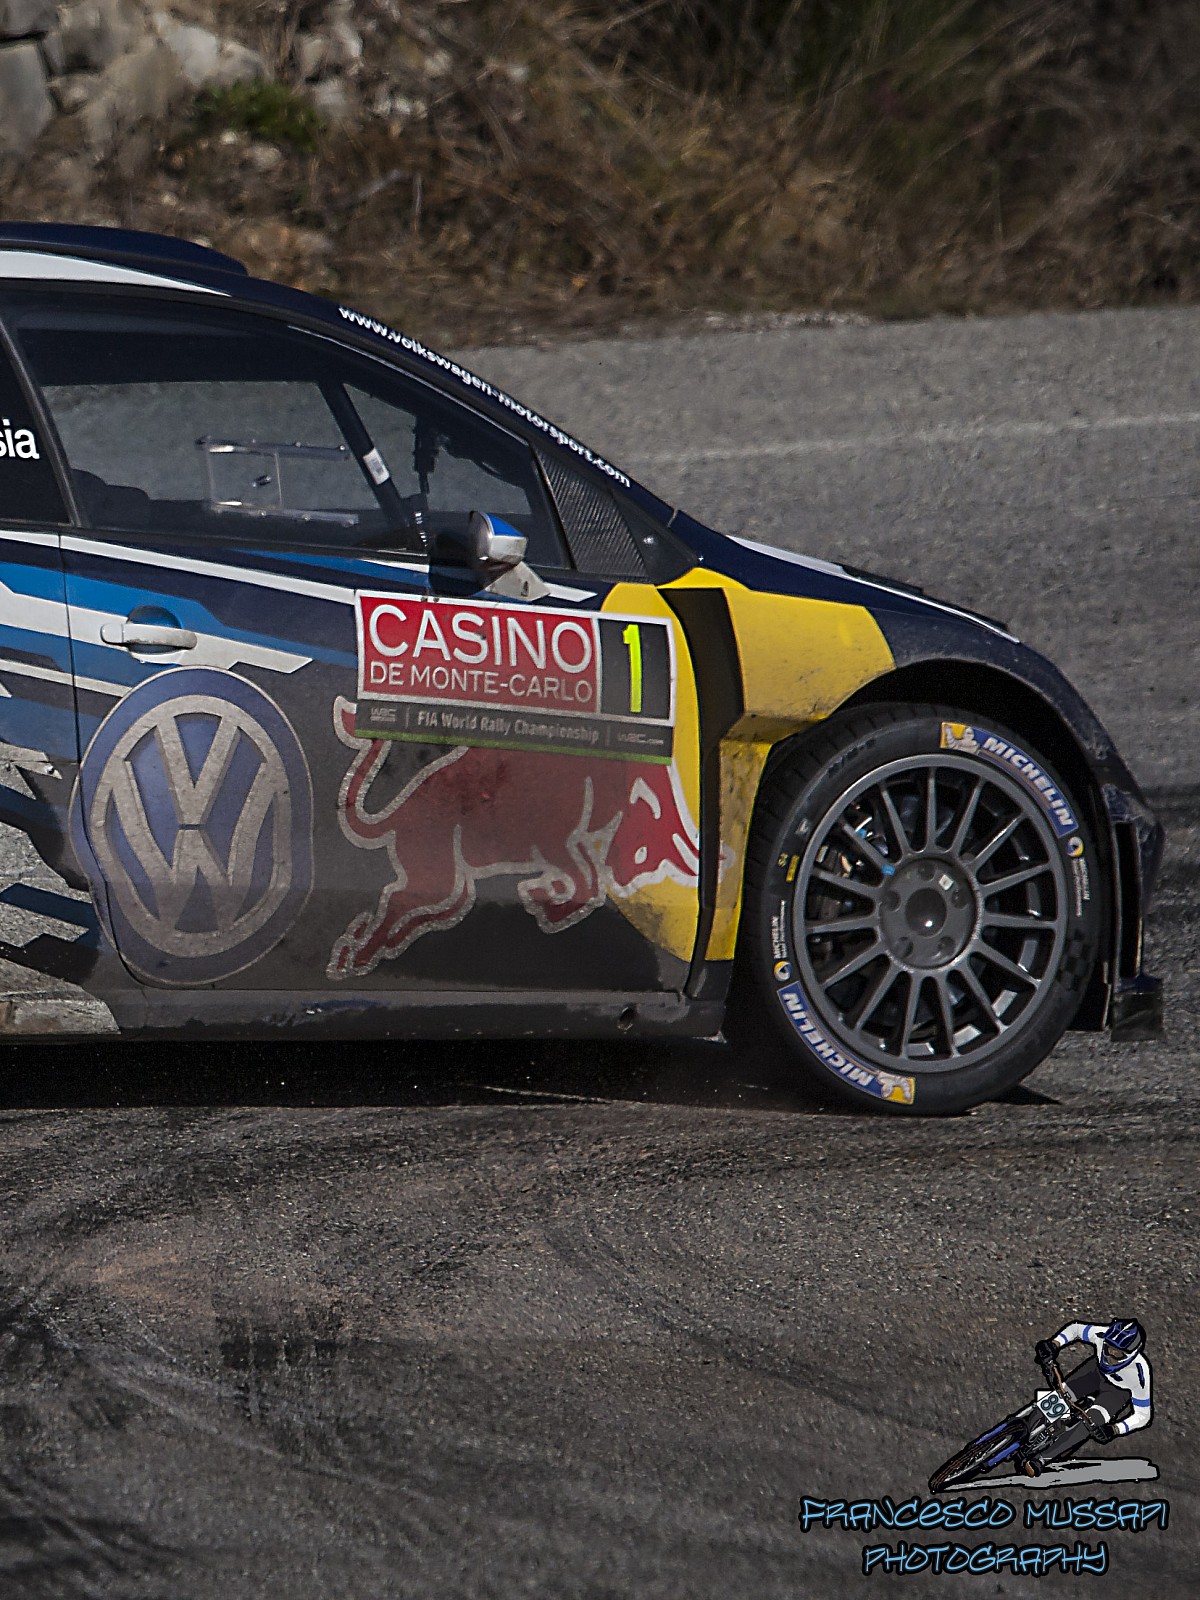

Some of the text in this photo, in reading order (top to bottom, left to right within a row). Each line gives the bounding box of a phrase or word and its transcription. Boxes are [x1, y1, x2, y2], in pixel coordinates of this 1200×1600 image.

[369, 604, 593, 673] CASINO
[623, 624, 643, 713] 1
[370, 661, 593, 704] DE MONTE-CARLO
[417, 710, 599, 745] FIA World Rally Championship
[982, 737, 1074, 826] MICHELIN
[782, 993, 875, 1087] MICHELIN
